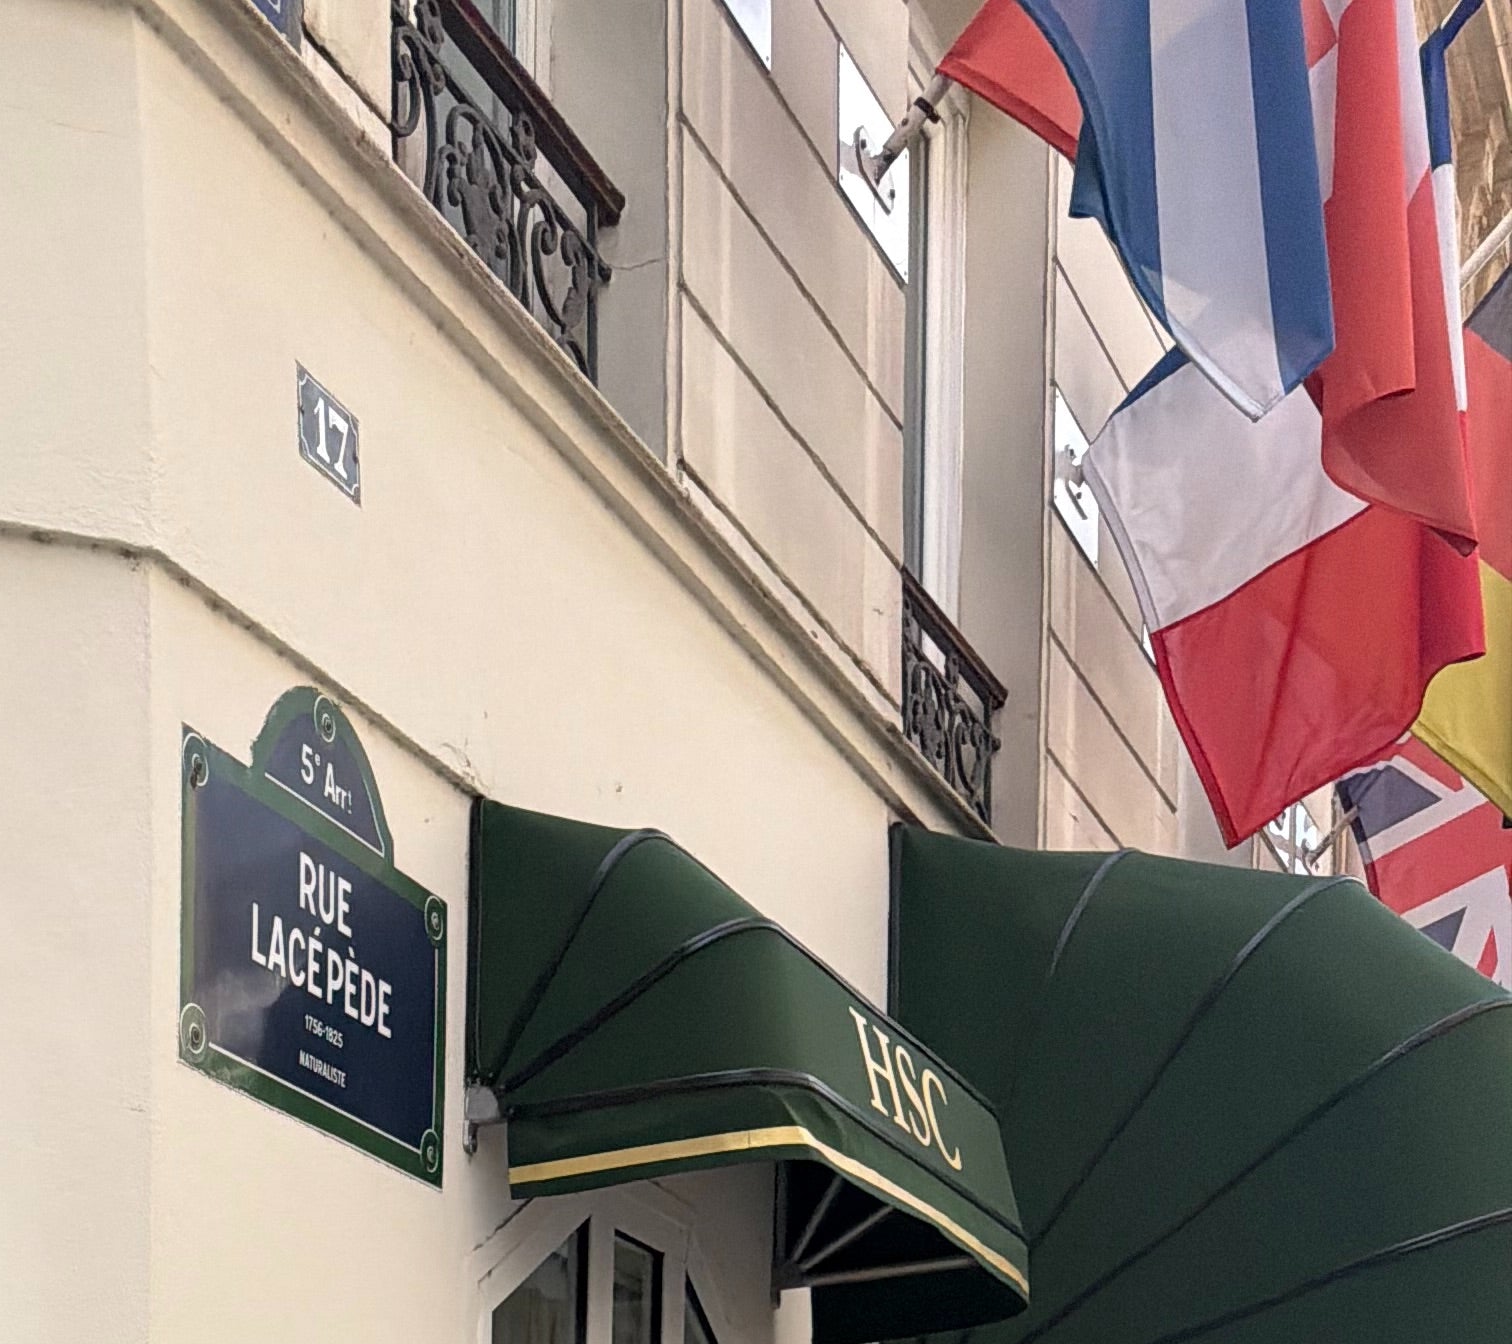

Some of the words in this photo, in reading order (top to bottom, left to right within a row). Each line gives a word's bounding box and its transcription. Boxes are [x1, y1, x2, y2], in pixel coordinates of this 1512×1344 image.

[314, 397, 349, 480] 17
[299, 851, 353, 938] RUE
[251, 902, 392, 1039] LACÉPÈDE
[299, 1049, 347, 1089] NATURALISTE
[305, 1013, 344, 1048] 1756-1825
[849, 1006, 963, 1171] HSC
